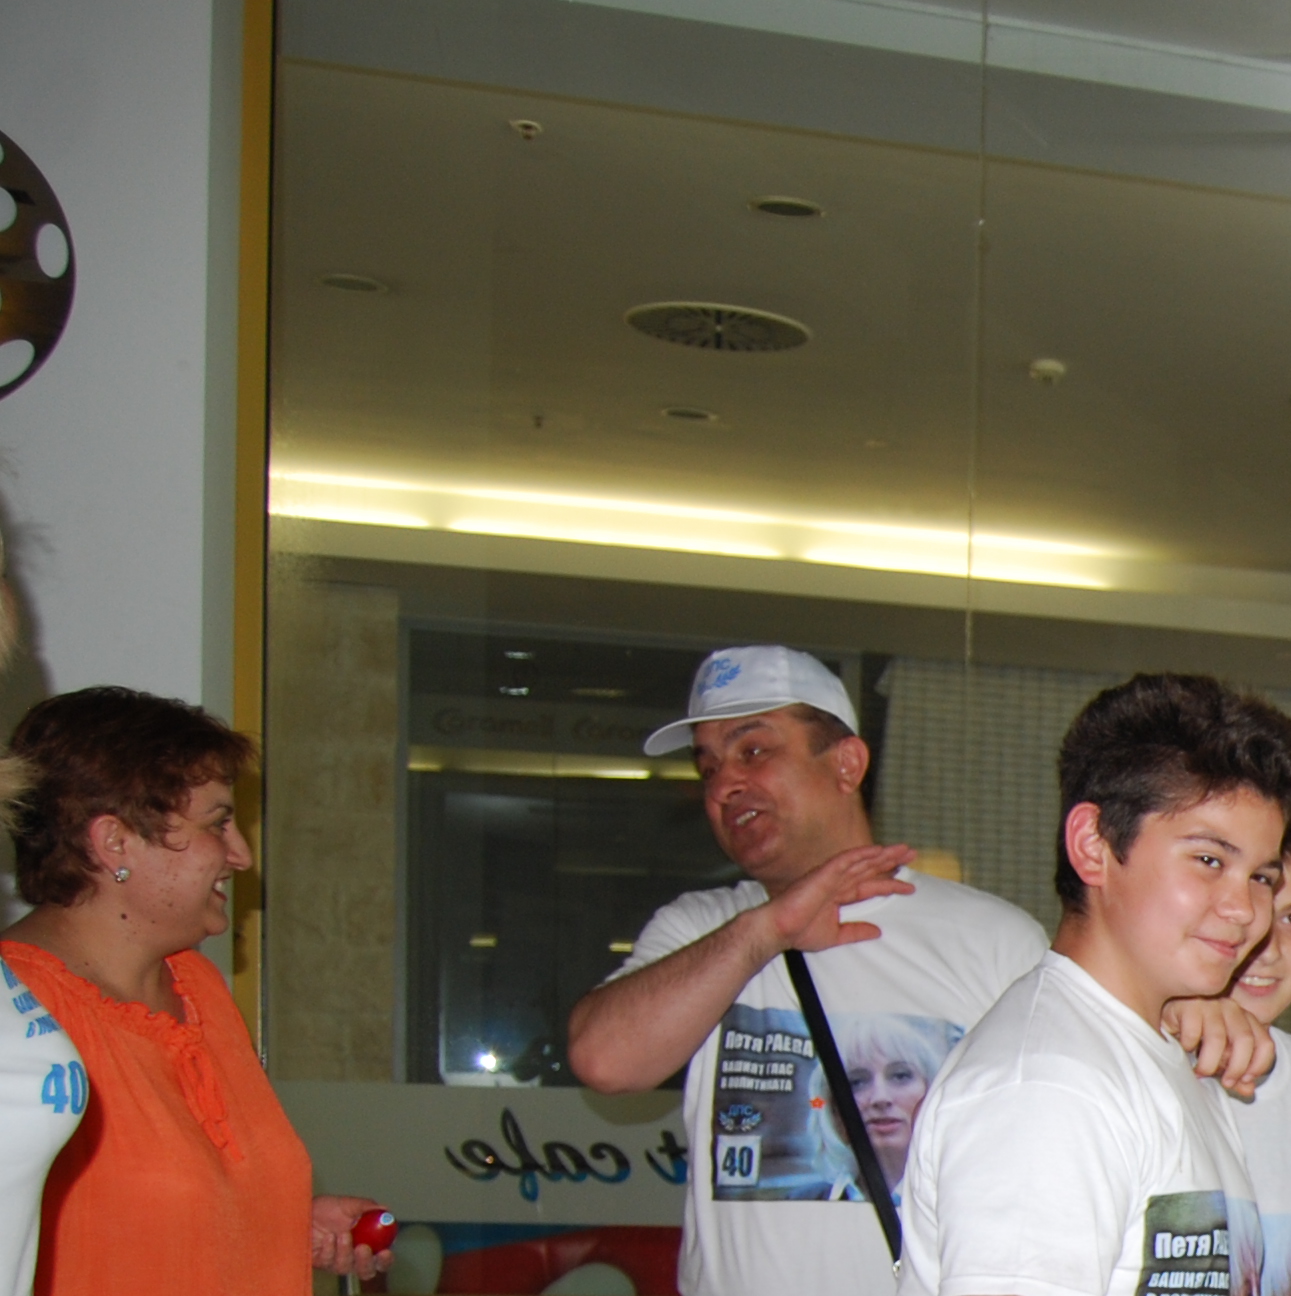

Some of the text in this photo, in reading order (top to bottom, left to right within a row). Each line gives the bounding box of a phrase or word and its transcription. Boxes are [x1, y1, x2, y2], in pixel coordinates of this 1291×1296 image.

[765, 1032, 814, 1059] РАЕВА
[41, 1060, 88, 1115] 40
[722, 1146, 754, 1177] 40
[1154, 1231, 1212, 1259] Петя
